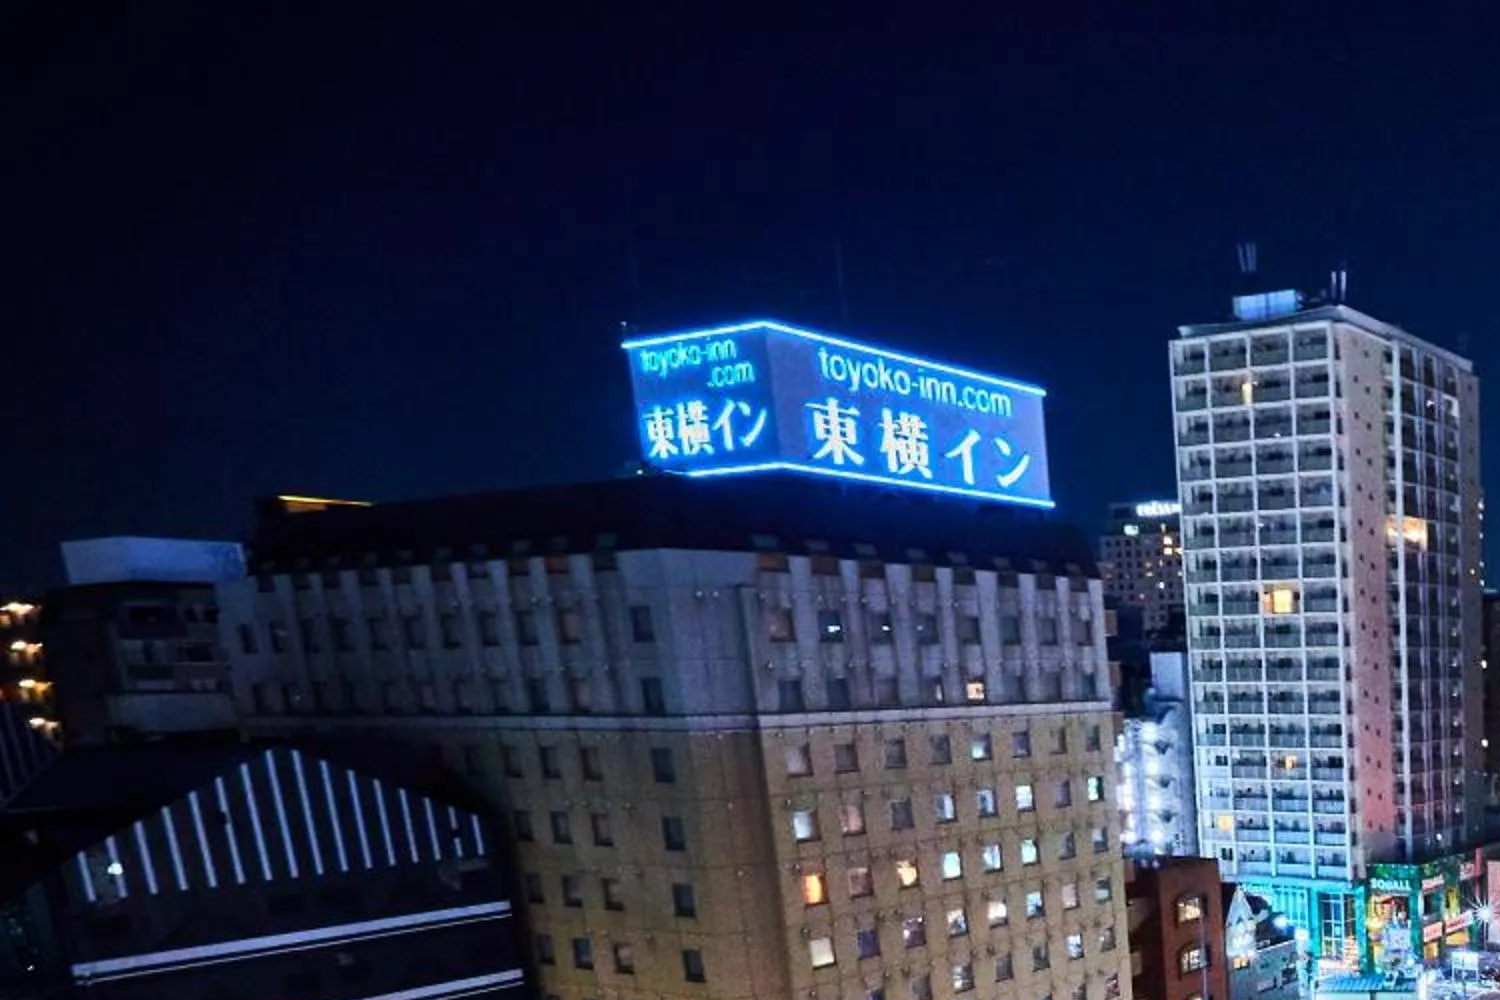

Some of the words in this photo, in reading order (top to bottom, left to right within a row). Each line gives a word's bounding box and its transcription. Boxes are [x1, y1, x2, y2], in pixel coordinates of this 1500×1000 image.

[640, 337, 737, 378] toyoko-inn
[707, 361, 756, 387] .com
[818, 347, 1012, 416] toyoko-inn.com
[642, 399, 767, 459] 東横イン
[805, 397, 1030, 487] 東横イン
